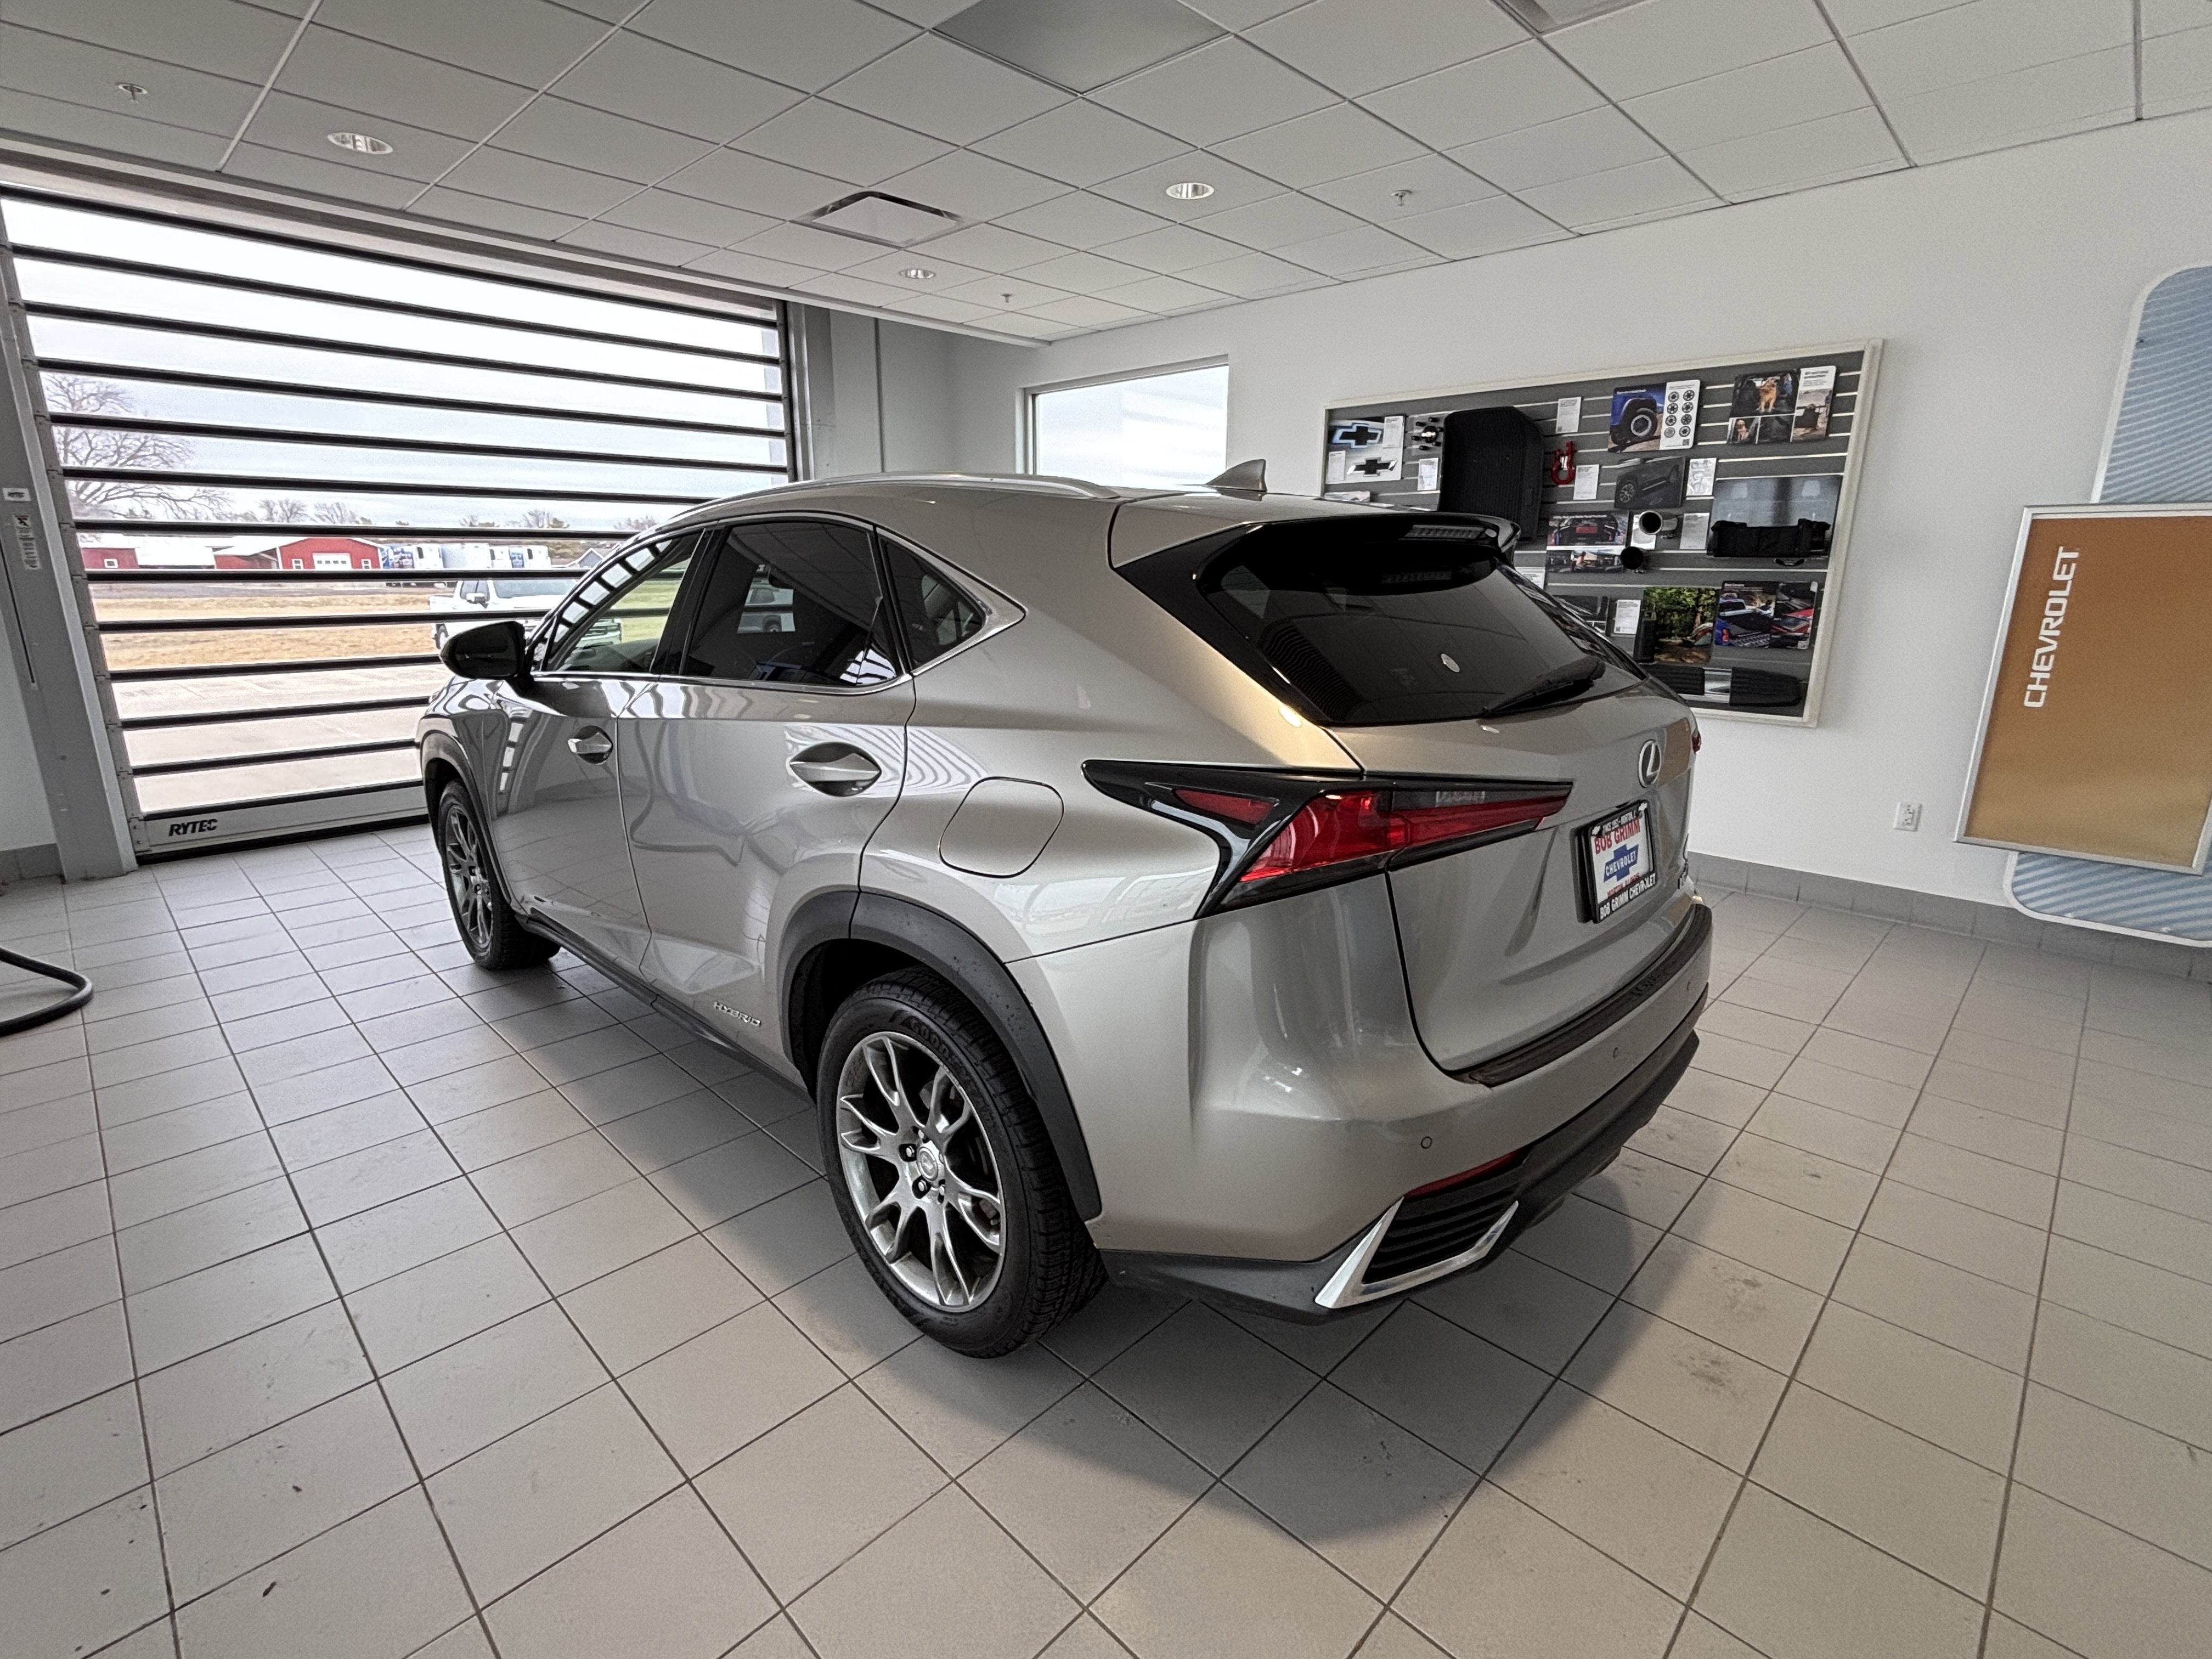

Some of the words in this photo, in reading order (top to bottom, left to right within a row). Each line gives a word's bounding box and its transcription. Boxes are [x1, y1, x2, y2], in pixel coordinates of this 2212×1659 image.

[2023, 546, 2079, 708] CHEVROLET
[168, 819, 218, 837] RYTEC
[1594, 833, 1612, 855] BOB
[1614, 819, 1640, 844] GRIMM
[1605, 850, 1637, 876] CHEVROLET
[1600, 902, 1611, 920] BOB
[1611, 890, 1628, 912] GRIMM
[1629, 873, 1656, 900] CHEVROLET
[714, 1001, 761, 1026] HYBRID
